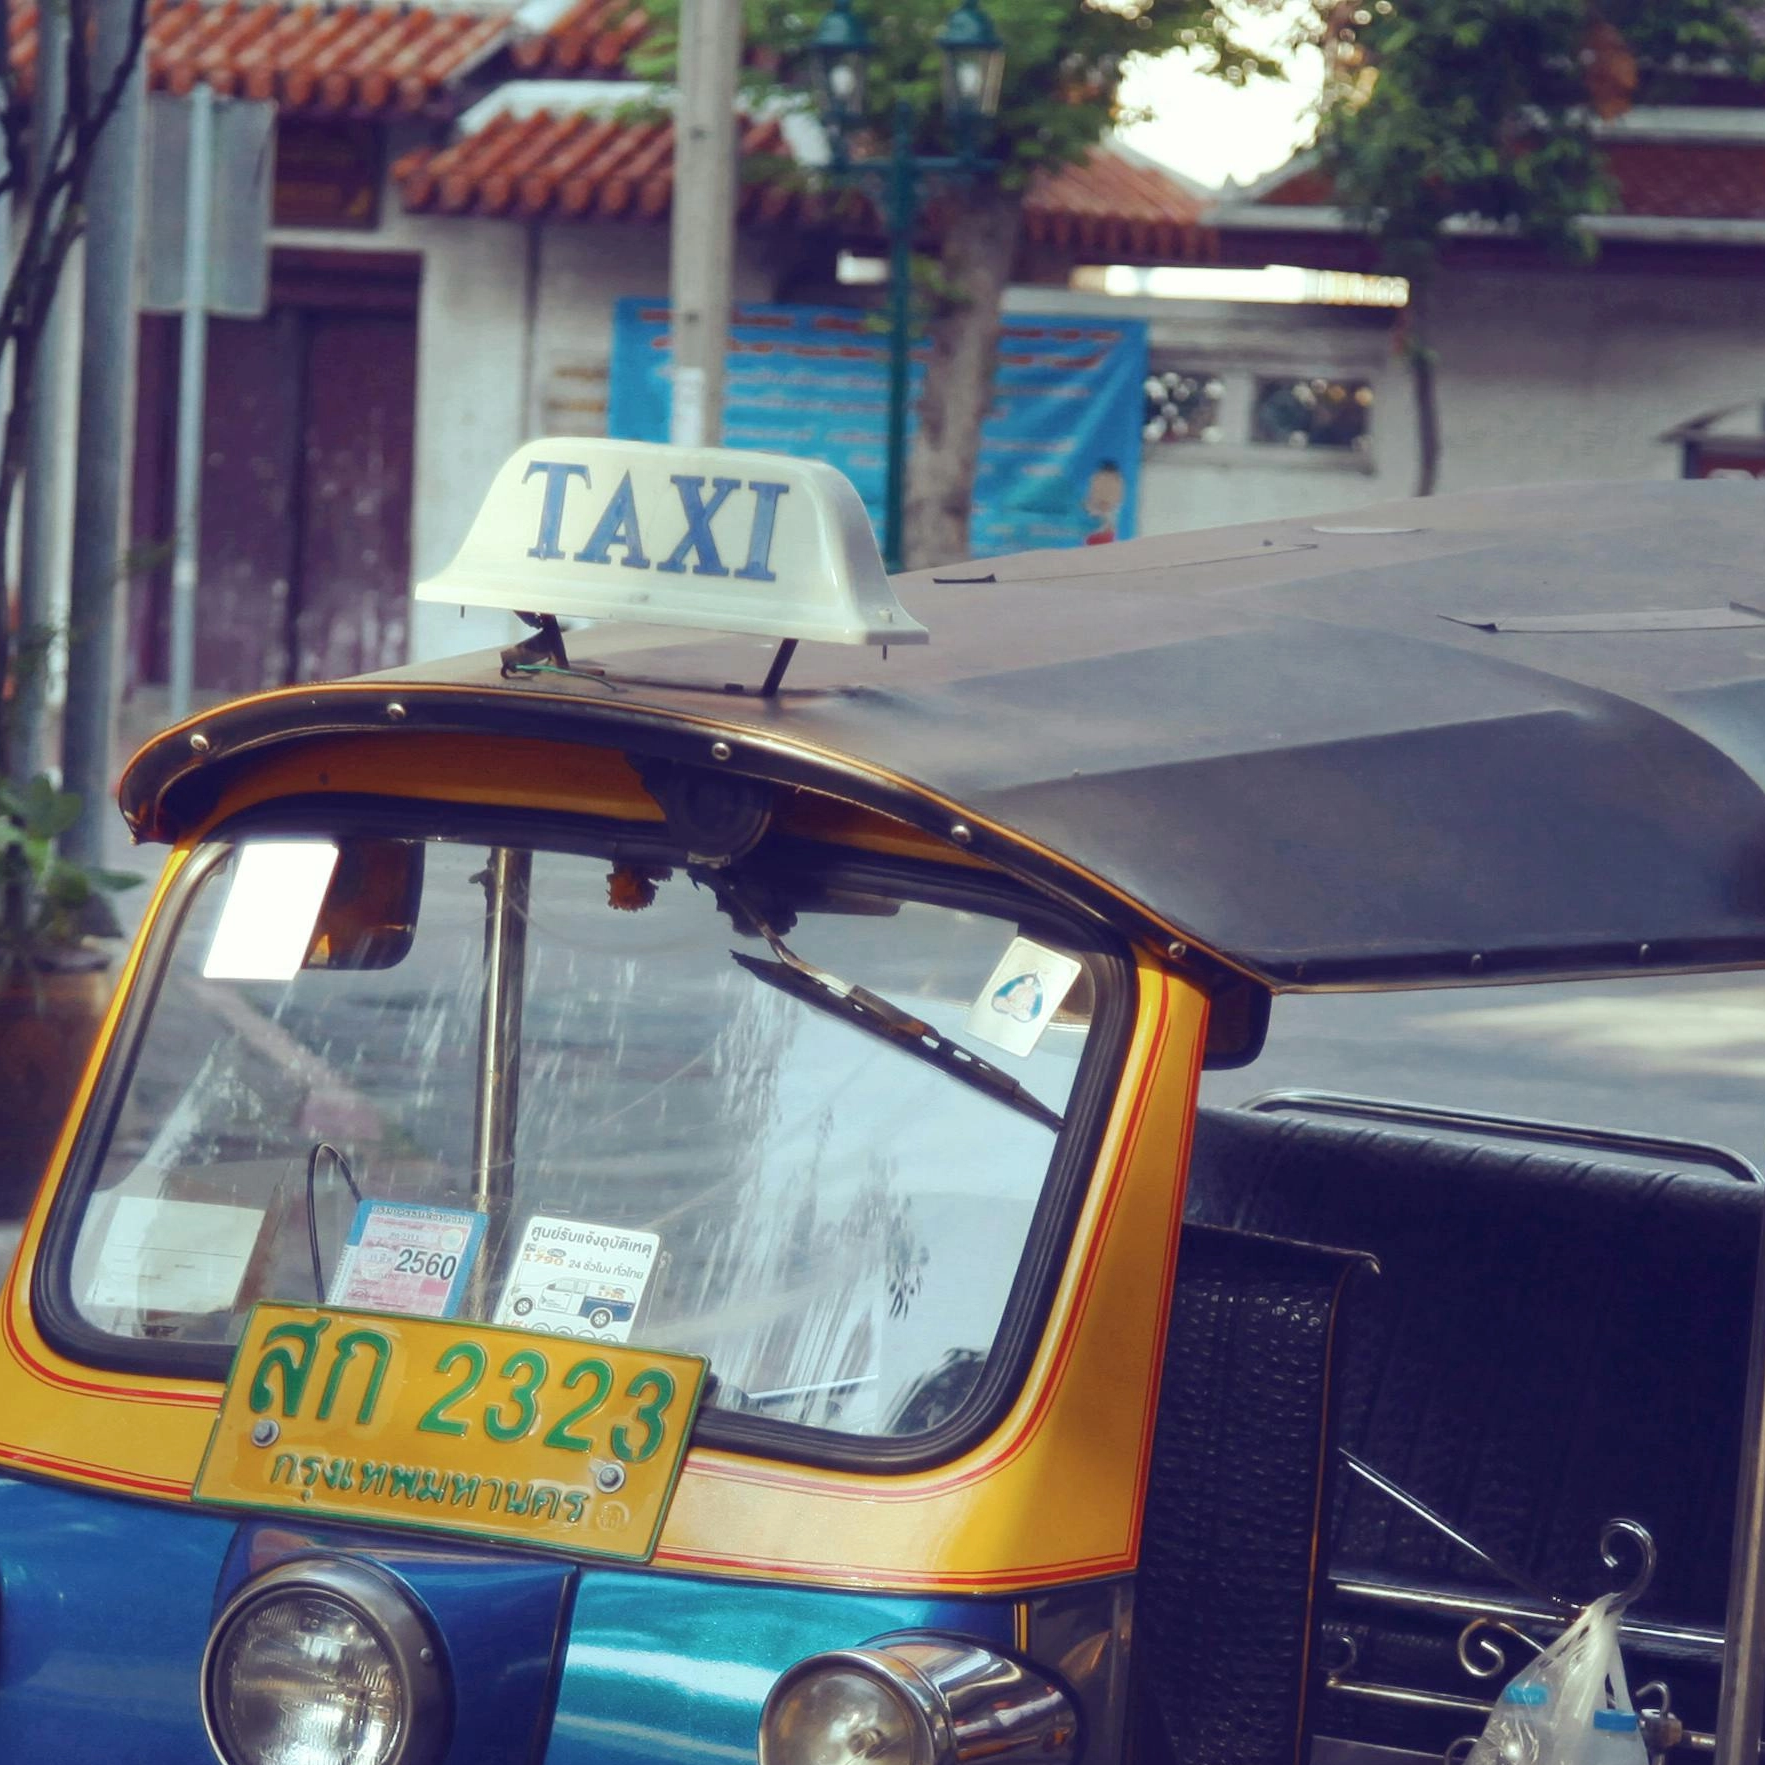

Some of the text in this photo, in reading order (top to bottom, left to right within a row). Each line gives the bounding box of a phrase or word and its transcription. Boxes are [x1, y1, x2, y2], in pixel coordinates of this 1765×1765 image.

[523, 460, 790, 583] TAXI
[394, 1248, 457, 1281] 2560
[523, 1252, 564, 1267] 1790
[568, 1260, 581, 1270] 24
[583, 1257, 612, 1275] ชั่วโมง
[613, 1263, 644, 1280] ทั่วไทย
[531, 1225, 653, 1258] ศูนย์รับแจ้งอุบัติเหตุ
[249, 1316, 676, 1464] สก 2323
[269, 1452, 592, 1524] กรุงเทพมหานคร
